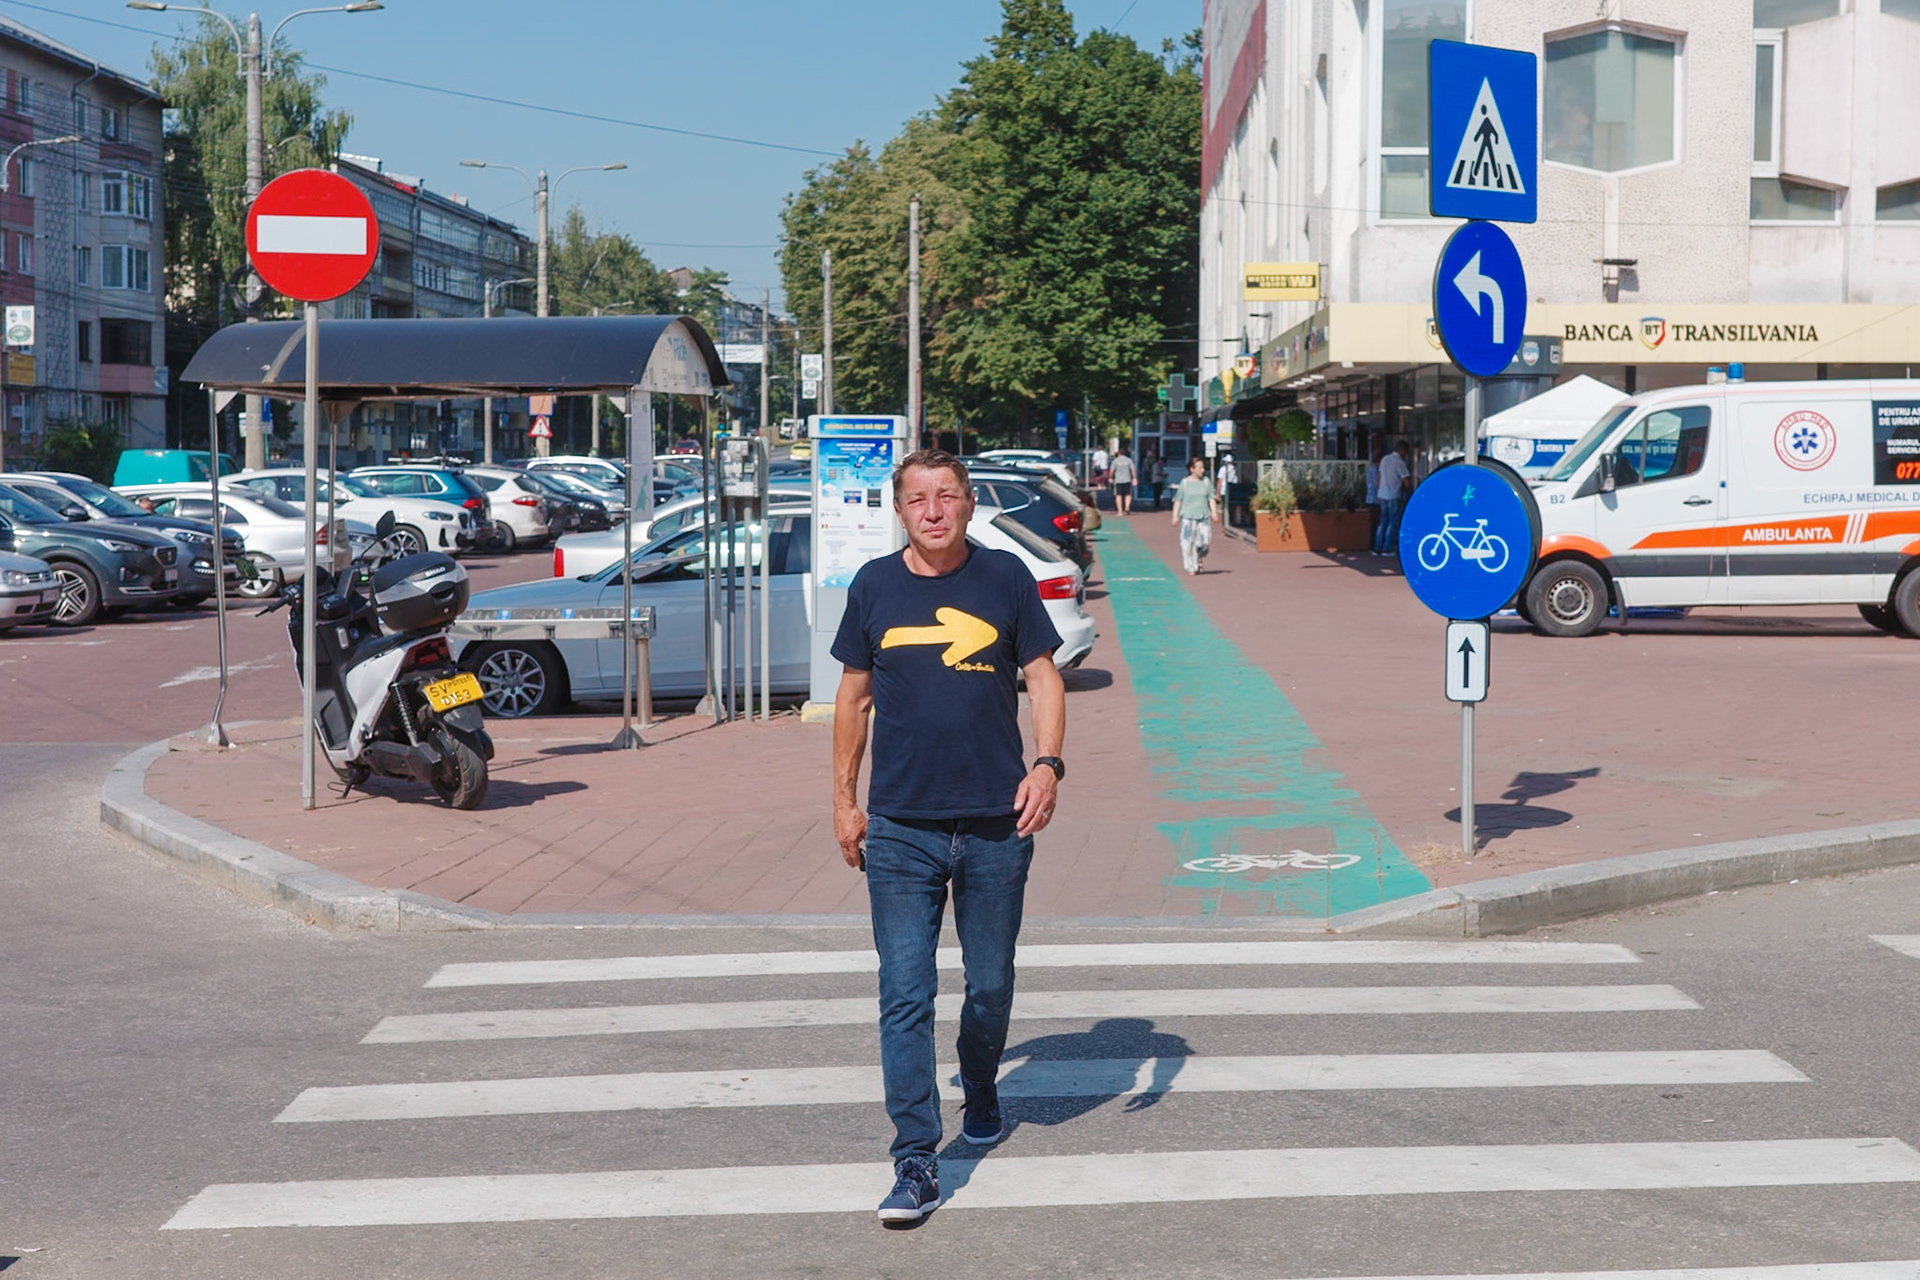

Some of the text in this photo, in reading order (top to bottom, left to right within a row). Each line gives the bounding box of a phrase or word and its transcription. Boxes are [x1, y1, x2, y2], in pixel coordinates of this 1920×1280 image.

[1564, 324, 1818, 342] BANCA BT TRANSILVANIA
[1878, 407, 1910, 416] PENTRU
[1879, 417, 1891, 426] DE
[1896, 462, 1920, 479] 077
[1550, 494, 1565, 503] B2
[1803, 493, 1853, 504] ECHIPAJ
[1856, 493, 1909, 502] MEDICAL
[1742, 527, 1833, 541] AMBULANTA
[429, 682, 448, 698] SV
